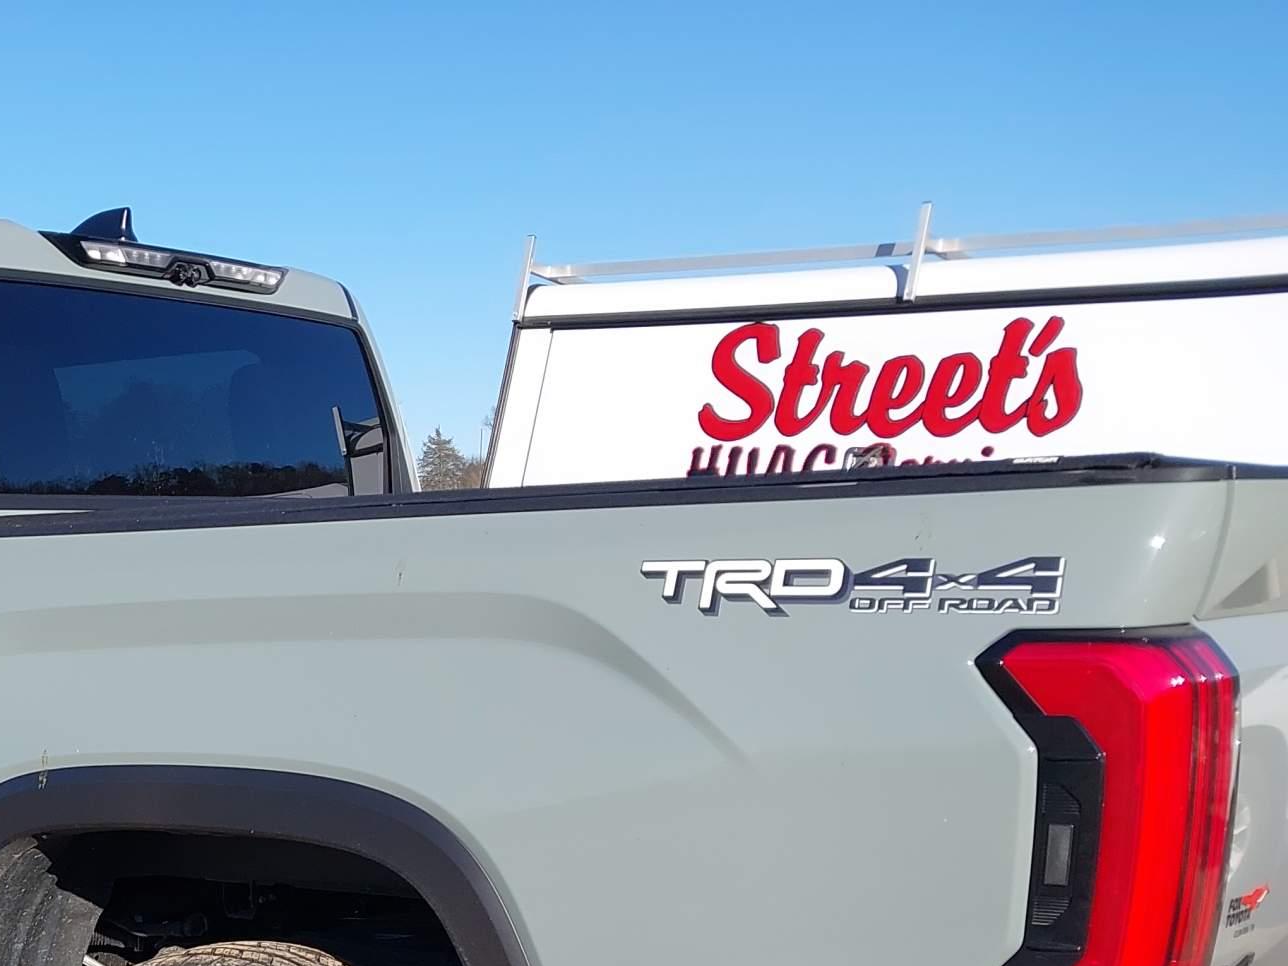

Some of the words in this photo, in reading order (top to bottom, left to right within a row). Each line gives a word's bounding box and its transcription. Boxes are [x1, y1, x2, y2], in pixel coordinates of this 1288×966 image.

[698, 315, 1083, 441] Street's
[641, 558, 854, 617] TRD
[851, 556, 1065, 599] 4x4
[848, 597, 932, 614] OFF
[938, 597, 1062, 616] ROAD
